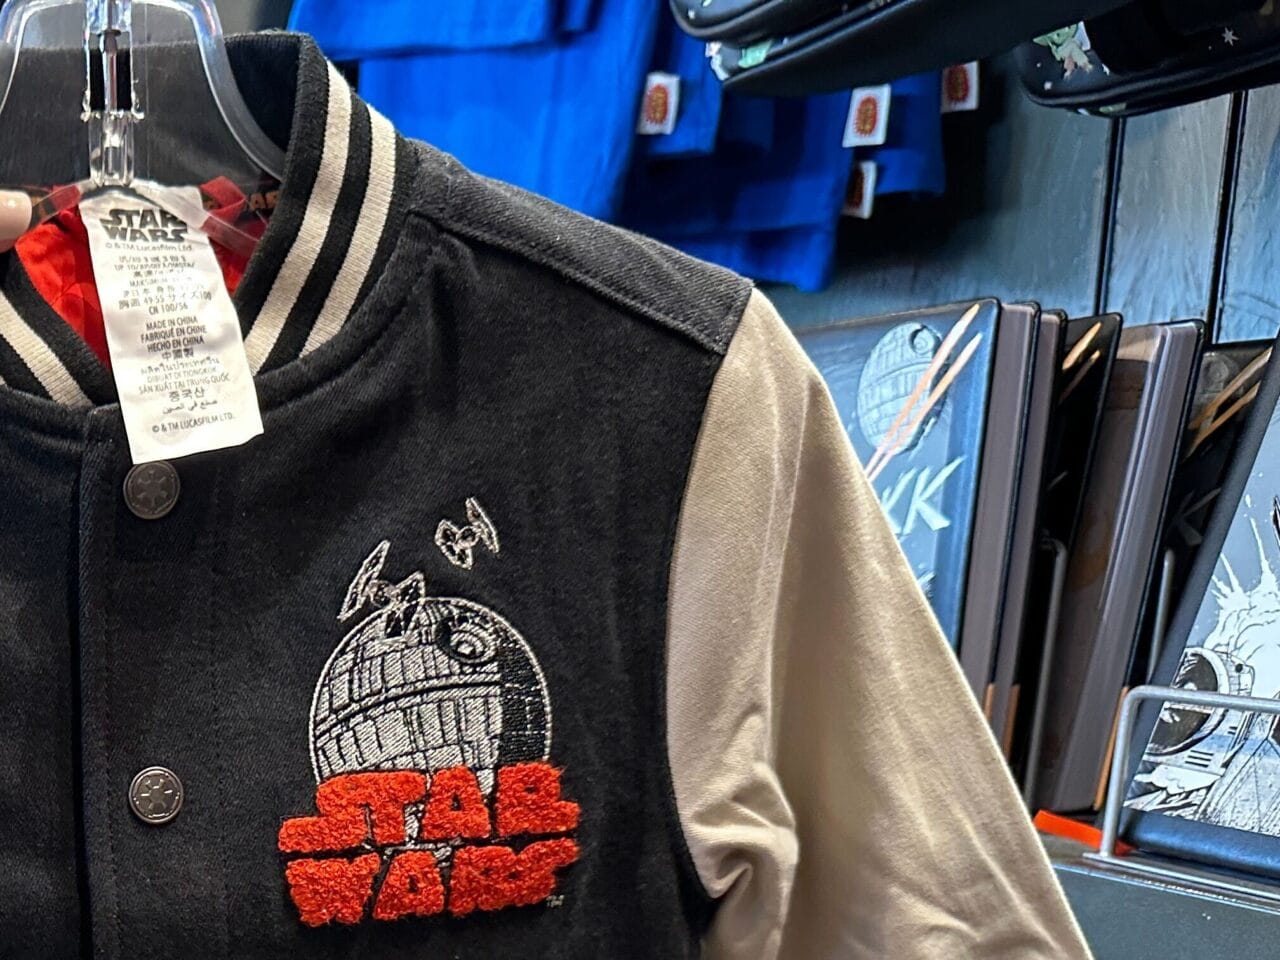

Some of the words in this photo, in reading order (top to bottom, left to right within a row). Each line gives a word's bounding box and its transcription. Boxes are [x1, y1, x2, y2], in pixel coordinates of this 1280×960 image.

[99, 208, 187, 229] STAR
[102, 225, 187, 242] WARS
[146, 319, 166, 330] MADE
[167, 317, 175, 326] IN
[176, 316, 198, 326] CHINA
[140, 328, 175, 343] FABRIQUÉ
[176, 326, 185, 337] EN
[186, 325, 207, 335] CHINE
[147, 340, 171, 352] HECHO
[172, 339, 181, 349] EN
[182, 335, 204, 346] CHINA
[152, 425, 160, 433] ©
[168, 422, 179, 431] TM
[180, 415, 218, 430] LUCASFILM
[278, 761, 581, 853] STAR
[285, 836, 581, 928] WARS
